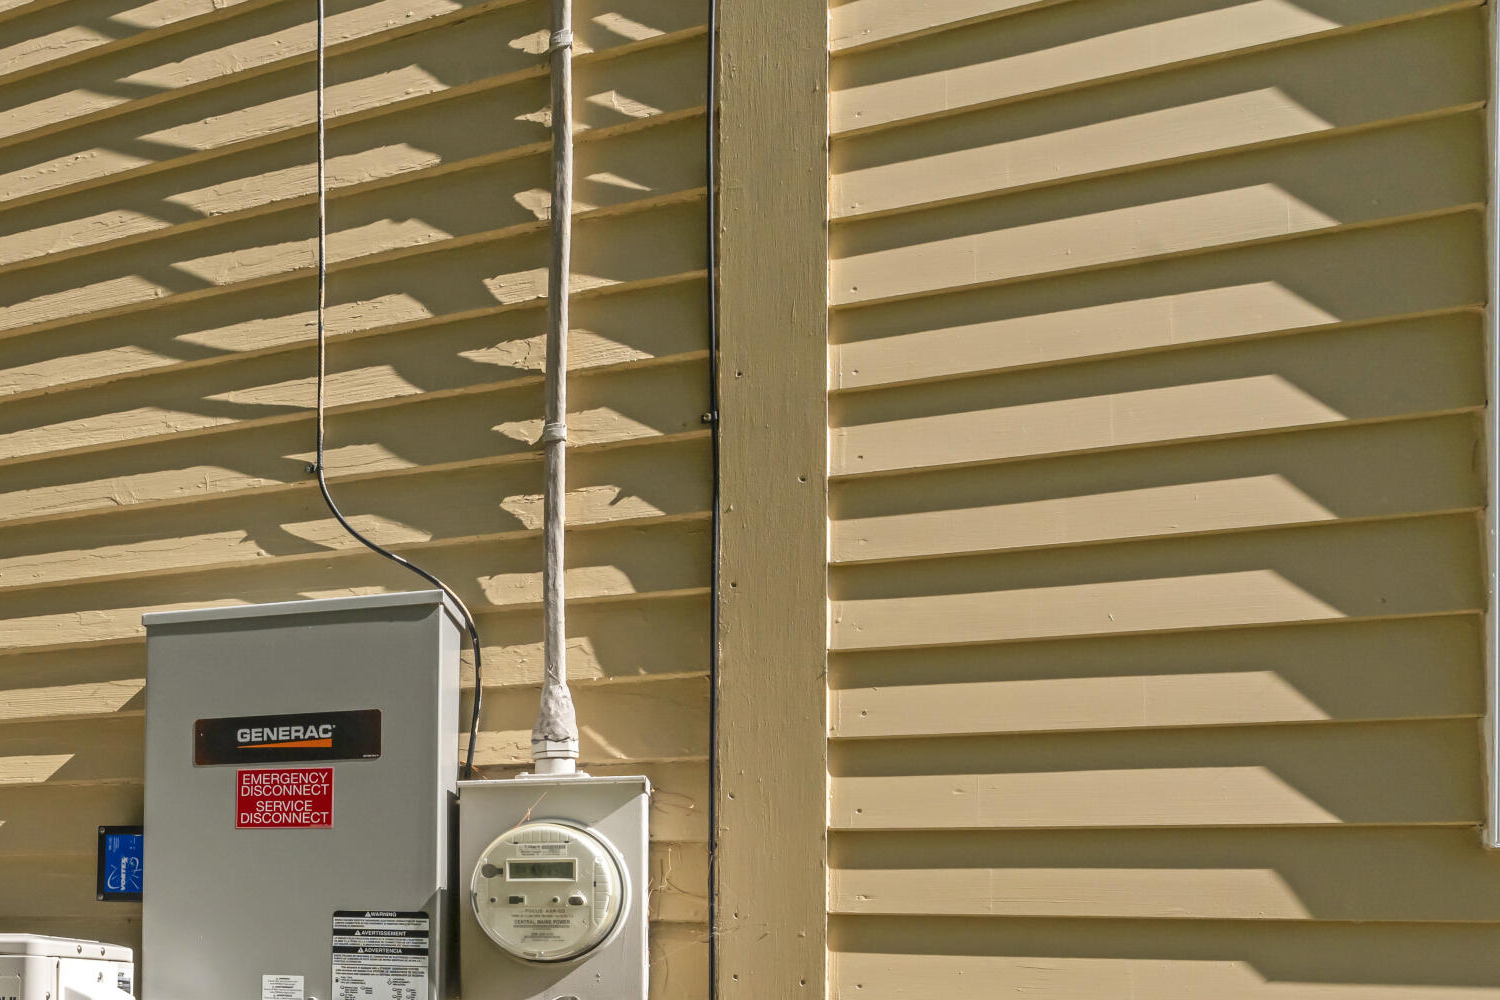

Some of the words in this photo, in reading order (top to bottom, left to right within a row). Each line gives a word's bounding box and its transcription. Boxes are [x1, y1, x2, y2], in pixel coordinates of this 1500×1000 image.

[236, 724, 333, 743] GENERAC
[242, 772, 329, 785] EMERGENCY
[241, 784, 330, 797] DISCONNECT
[255, 800, 313, 812] SERVICE
[240, 812, 329, 824] DISCONNECT
